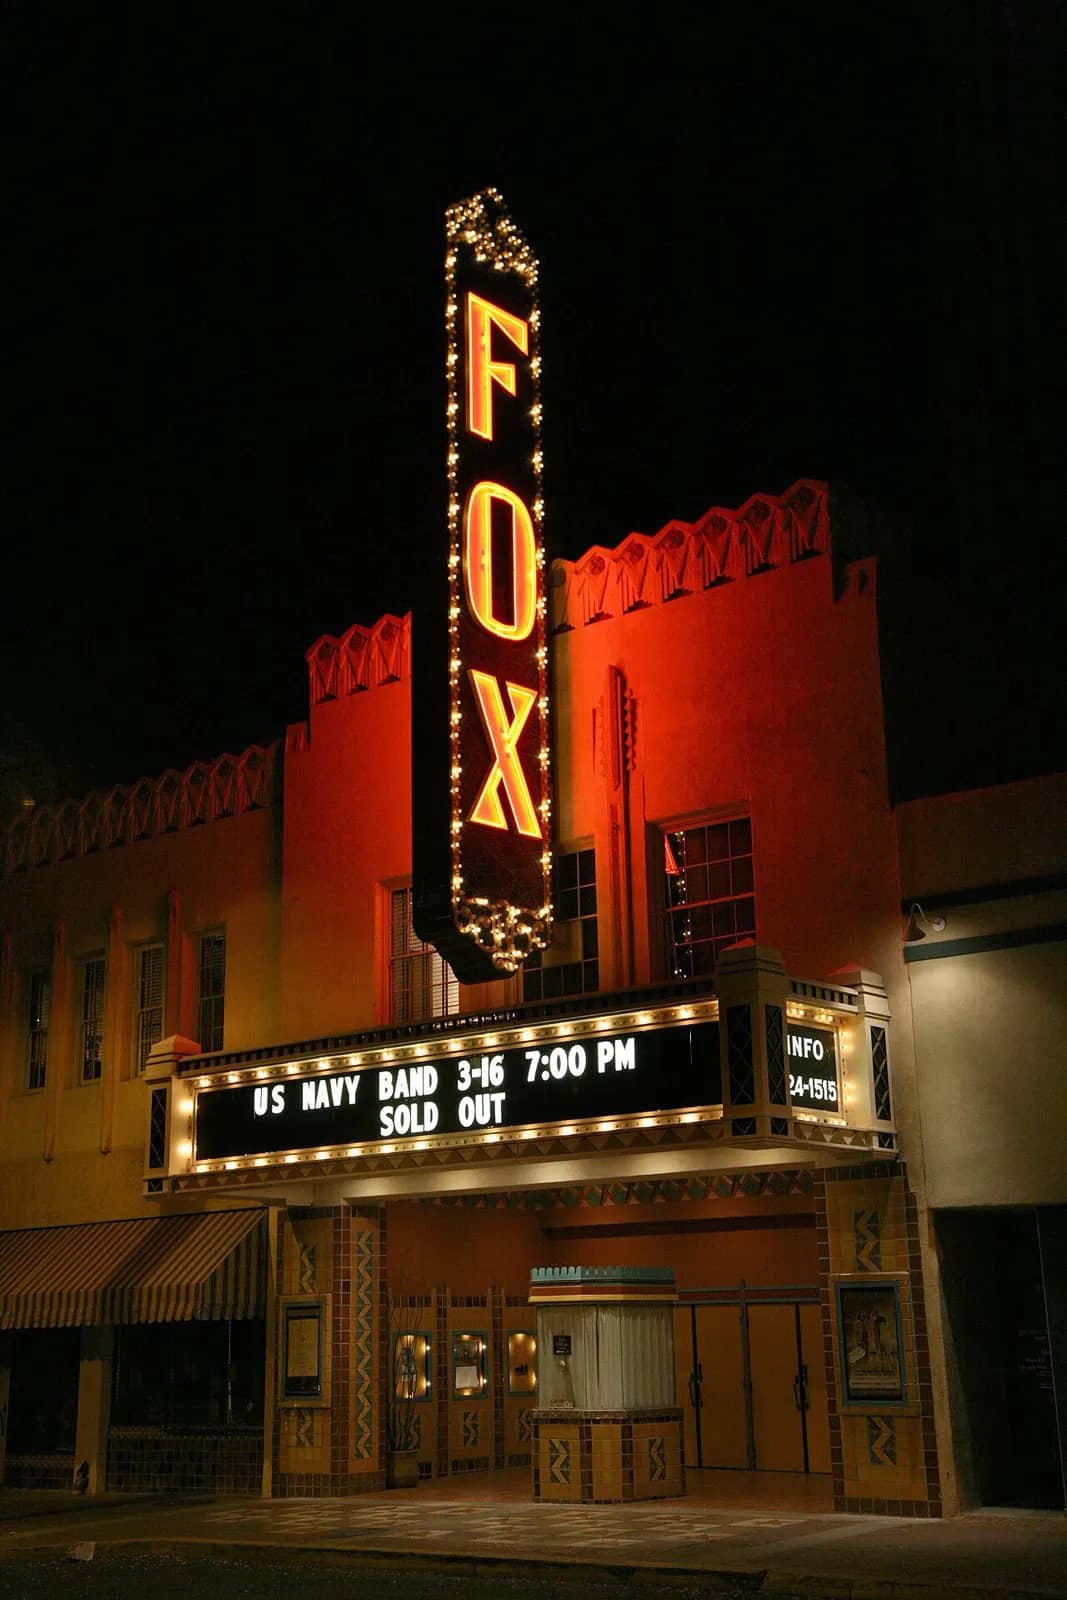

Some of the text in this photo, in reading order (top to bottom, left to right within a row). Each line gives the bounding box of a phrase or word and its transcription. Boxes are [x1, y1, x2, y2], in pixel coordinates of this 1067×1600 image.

[465, 291, 542, 840] FOX
[253, 1037, 636, 1116] US NAVY BAND 3-16 7:00 PM
[787, 1034, 823, 1060] INFO
[379, 1092, 506, 1137] SOLD OUT
